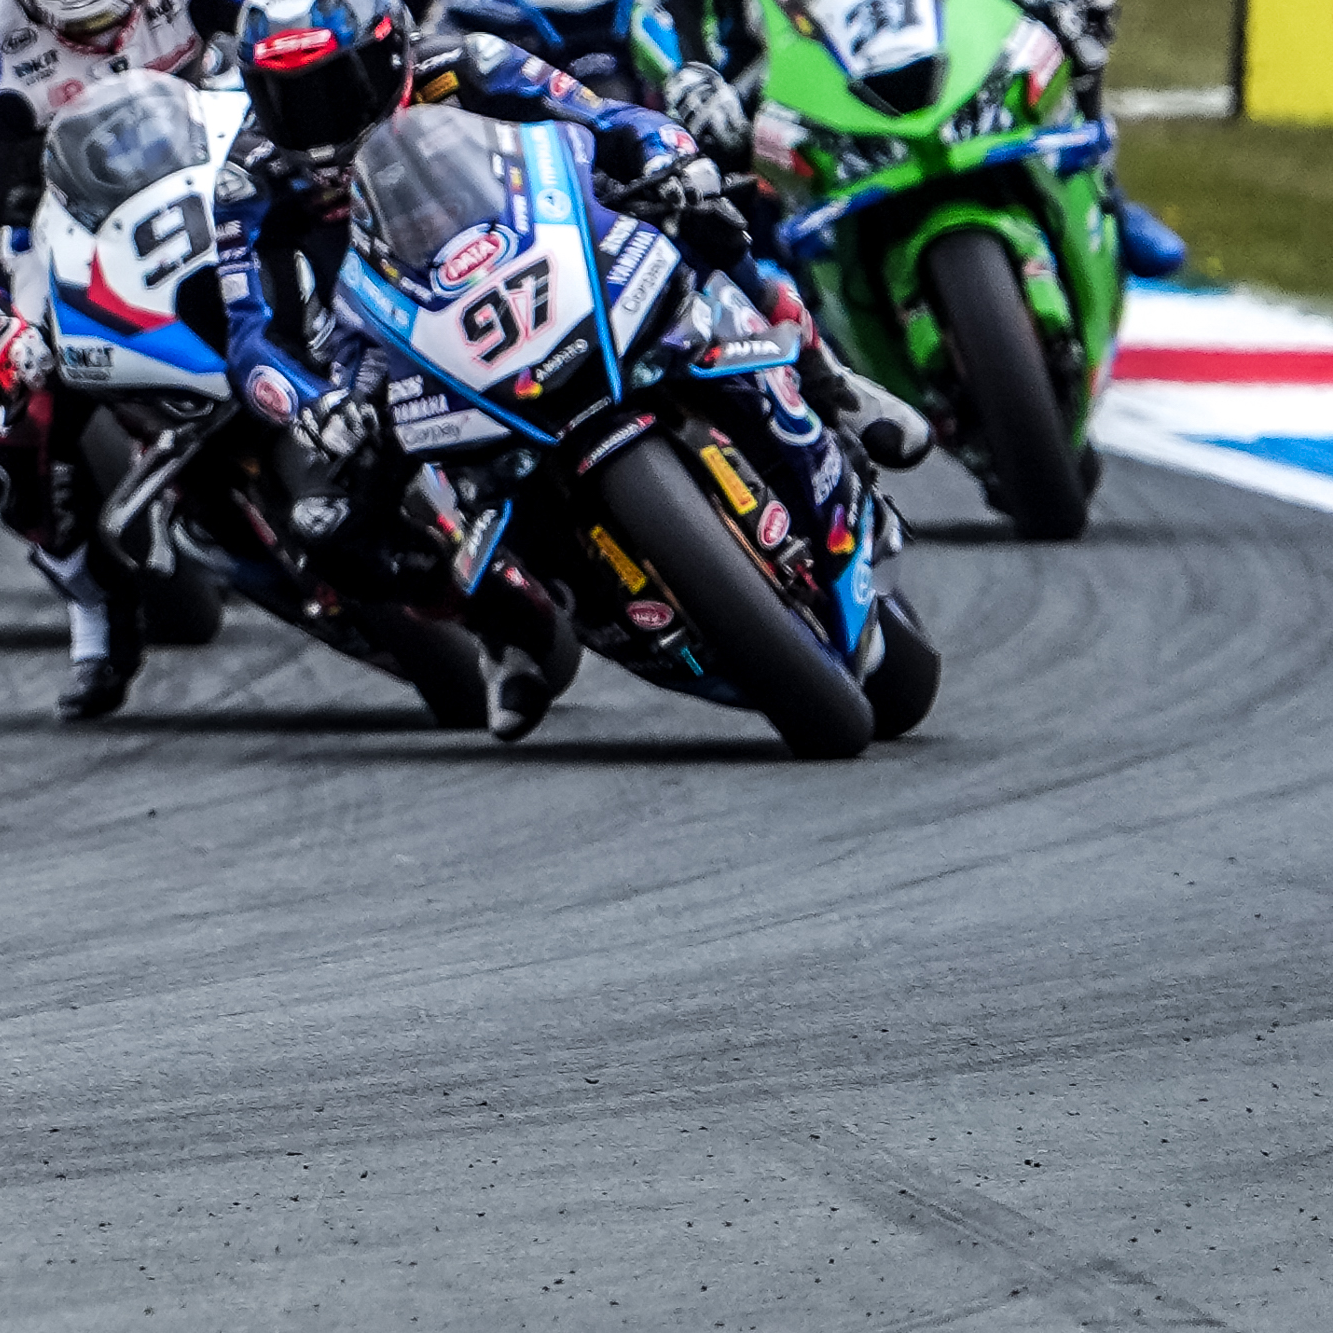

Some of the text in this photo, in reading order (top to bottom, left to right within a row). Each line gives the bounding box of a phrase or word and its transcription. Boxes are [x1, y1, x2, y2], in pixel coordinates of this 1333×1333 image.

[134, 193, 213, 291] 9
[606, 231, 658, 284] YAMAHA
[458, 253, 557, 368] 97
